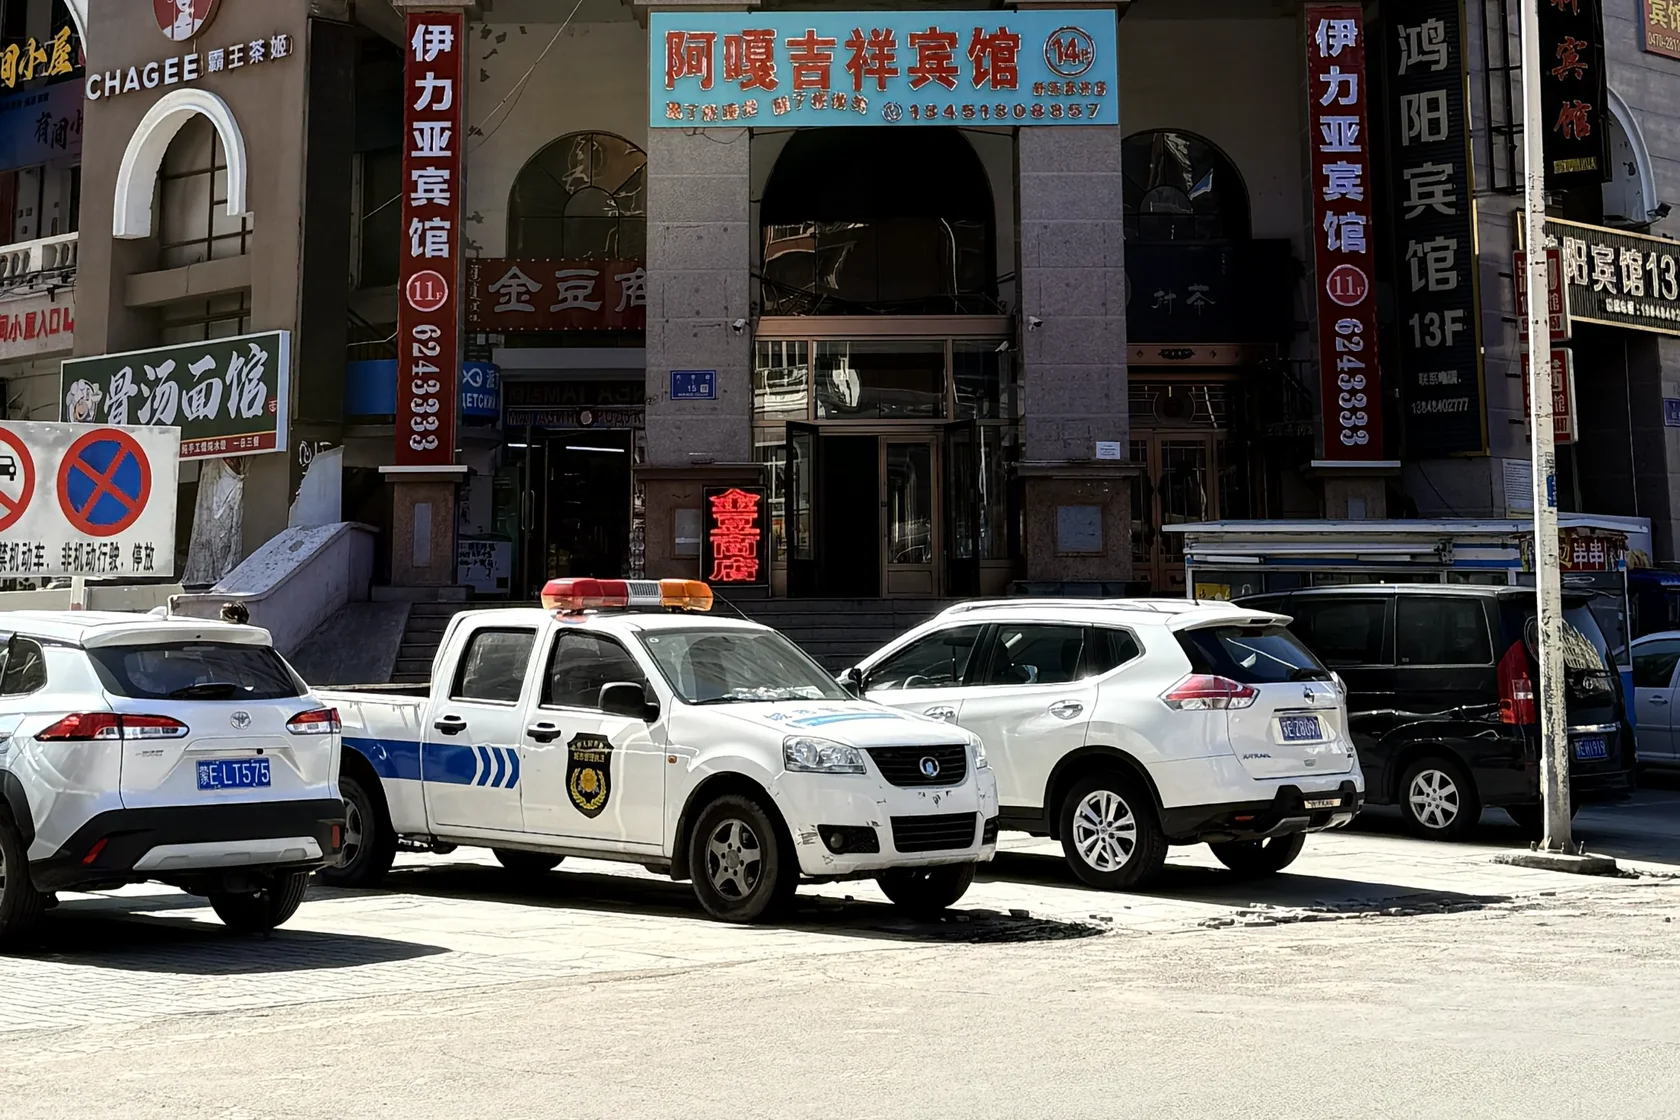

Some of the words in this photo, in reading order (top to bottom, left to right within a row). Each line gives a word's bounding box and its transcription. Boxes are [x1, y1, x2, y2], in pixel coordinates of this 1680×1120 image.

[85, 53, 199, 101] CHAGEE
[208, 33, 290, 73] 霸王茶姬
[664, 26, 1022, 93] 阿嘎吉祥宾馆
[409, 23, 454, 259] 伊力亚宾馆
[1314, 18, 1368, 254] 伊力亚宾馆
[1398, 18, 1459, 292] 鸿阳宾馆
[412, 280, 444, 302] 11F
[1333, 275, 1364, 296] 11F
[1546, 236, 1678, 300] 阳宾馆13
[1409, 309, 1464, 350] 13F
[103, 343, 268, 426] 骨汤面馆
[409, 323, 442, 452] 6243333
[1334, 317, 1369, 447] 6243333
